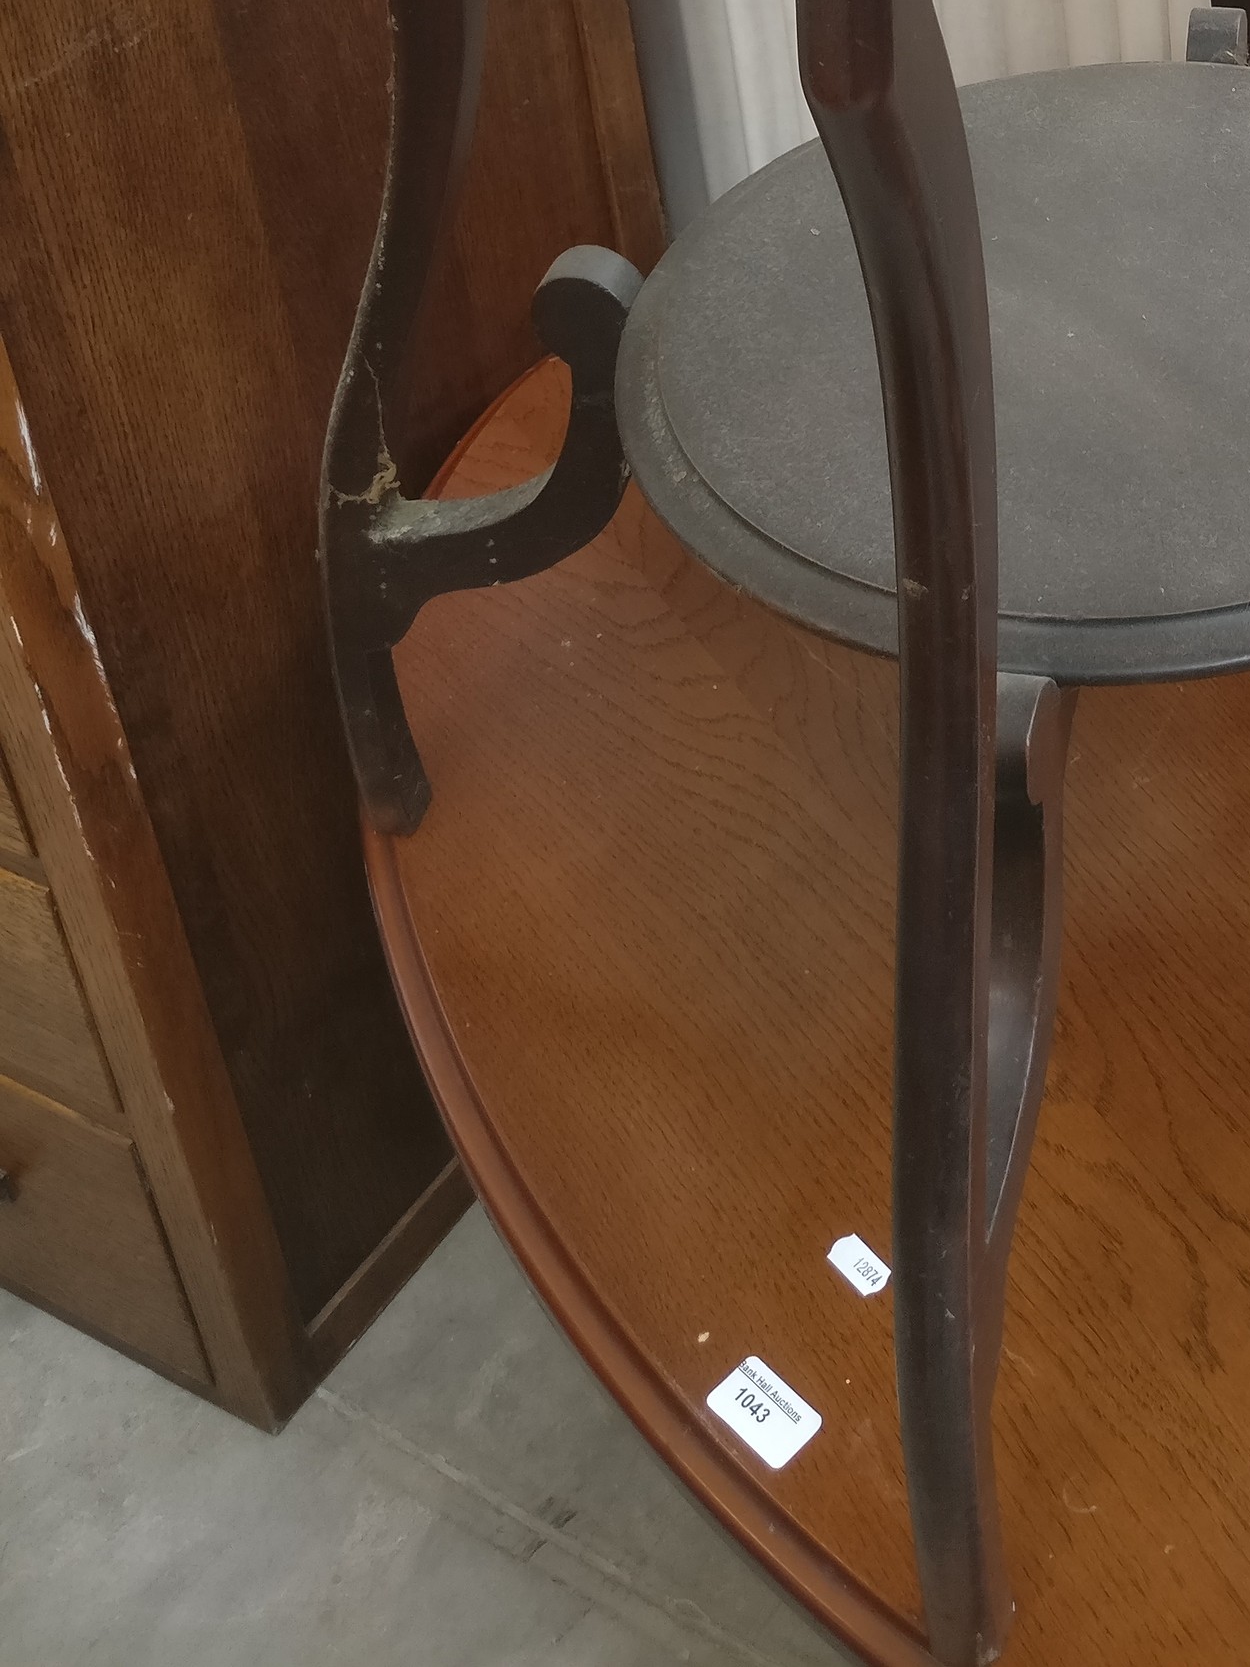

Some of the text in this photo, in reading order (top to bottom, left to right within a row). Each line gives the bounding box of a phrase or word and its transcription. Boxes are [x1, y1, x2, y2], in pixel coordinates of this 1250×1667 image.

[853, 1257, 883, 1287] 12874
[734, 1387, 770, 1423] 1043
[739, 1360, 802, 1422] Bank Hall Auctions
